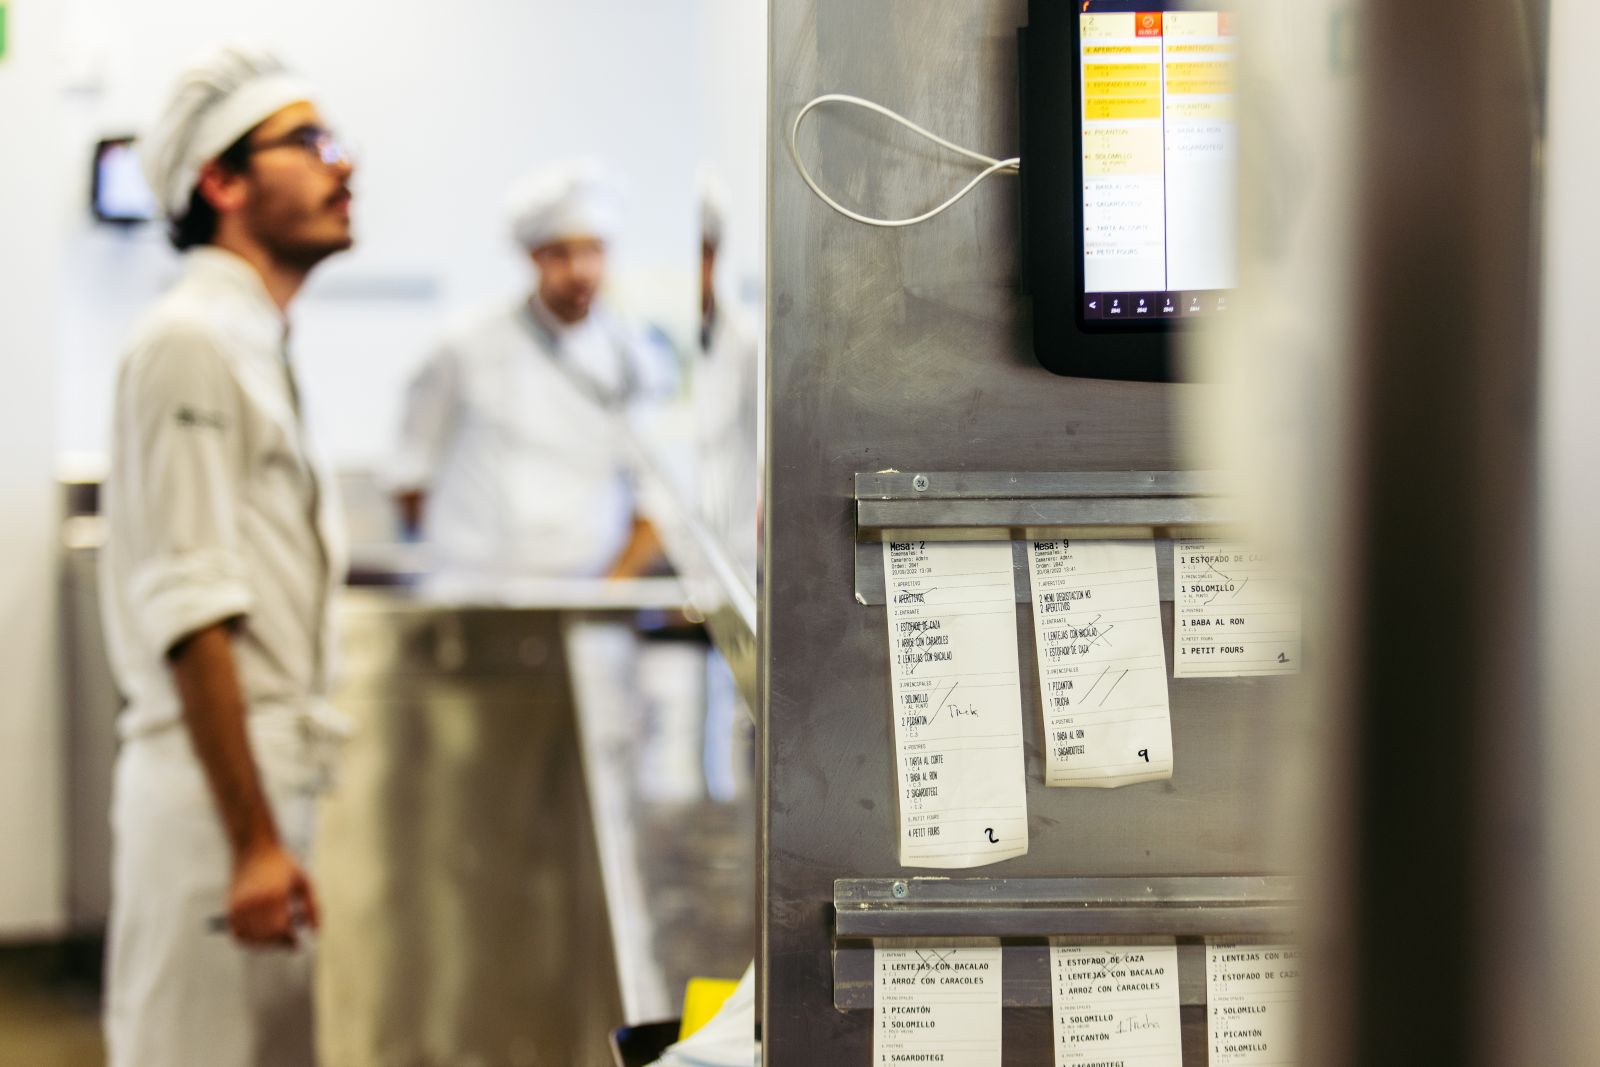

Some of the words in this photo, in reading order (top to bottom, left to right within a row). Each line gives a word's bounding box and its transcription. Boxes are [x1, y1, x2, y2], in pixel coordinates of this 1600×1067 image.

[890, 542, 915, 551] Mesa:
[920, 540, 926, 550] 2
[1034, 542, 1058, 551] Mesa:
[1064, 539, 1069, 548] 9
[1190, 556, 1229, 564] ESTOFADO
[1191, 584, 1234, 592] SOLOMILLO
[899, 593, 925, 604] APERITIVOS
[1046, 602, 1070, 612] APERITIVOS
[1048, 630, 1068, 640] LENTEJAS
[1050, 646, 1070, 657] ESTOFADO
[906, 694, 928, 704] SOLOMILLO
[1054, 697, 1070, 706] TRUCHA
[1057, 731, 1068, 741] BABA
[1076, 730, 1084, 738] RON
[910, 756, 922, 766] TARTA
[924, 756, 929, 764] AL
[930, 754, 944, 764] CORTE
[910, 772, 920, 782] BABA
[930, 771, 938, 780] RON
[912, 828, 926, 838] PETIT
[928, 826, 940, 836] FOURS
[984, 827, 999, 844] 2
[1067, 958, 1106, 966] ESTOFADO
[1126, 955, 1144, 963] CAZA
[1222, 954, 1260, 962] LENTEJAS
[1068, 972, 1106, 980] LENTEJAS
[1130, 968, 1164, 976] BACALAO
[1222, 972, 1260, 980] ESTOFADO
[1068, 986, 1092, 994] ARROZ
[1116, 983, 1160, 992] CARACOLES
[892, 1006, 930, 1014] PICANTÓN
[1223, 1006, 1266, 1014] SOLOMILLO
[1070, 1014, 1113, 1024] SOLOMILLO
[1070, 1032, 1110, 1042] PICANTÓN
[1224, 1029, 1262, 1038] PICANTÓN
[1224, 1044, 1267, 1052] SOLOMILLO
